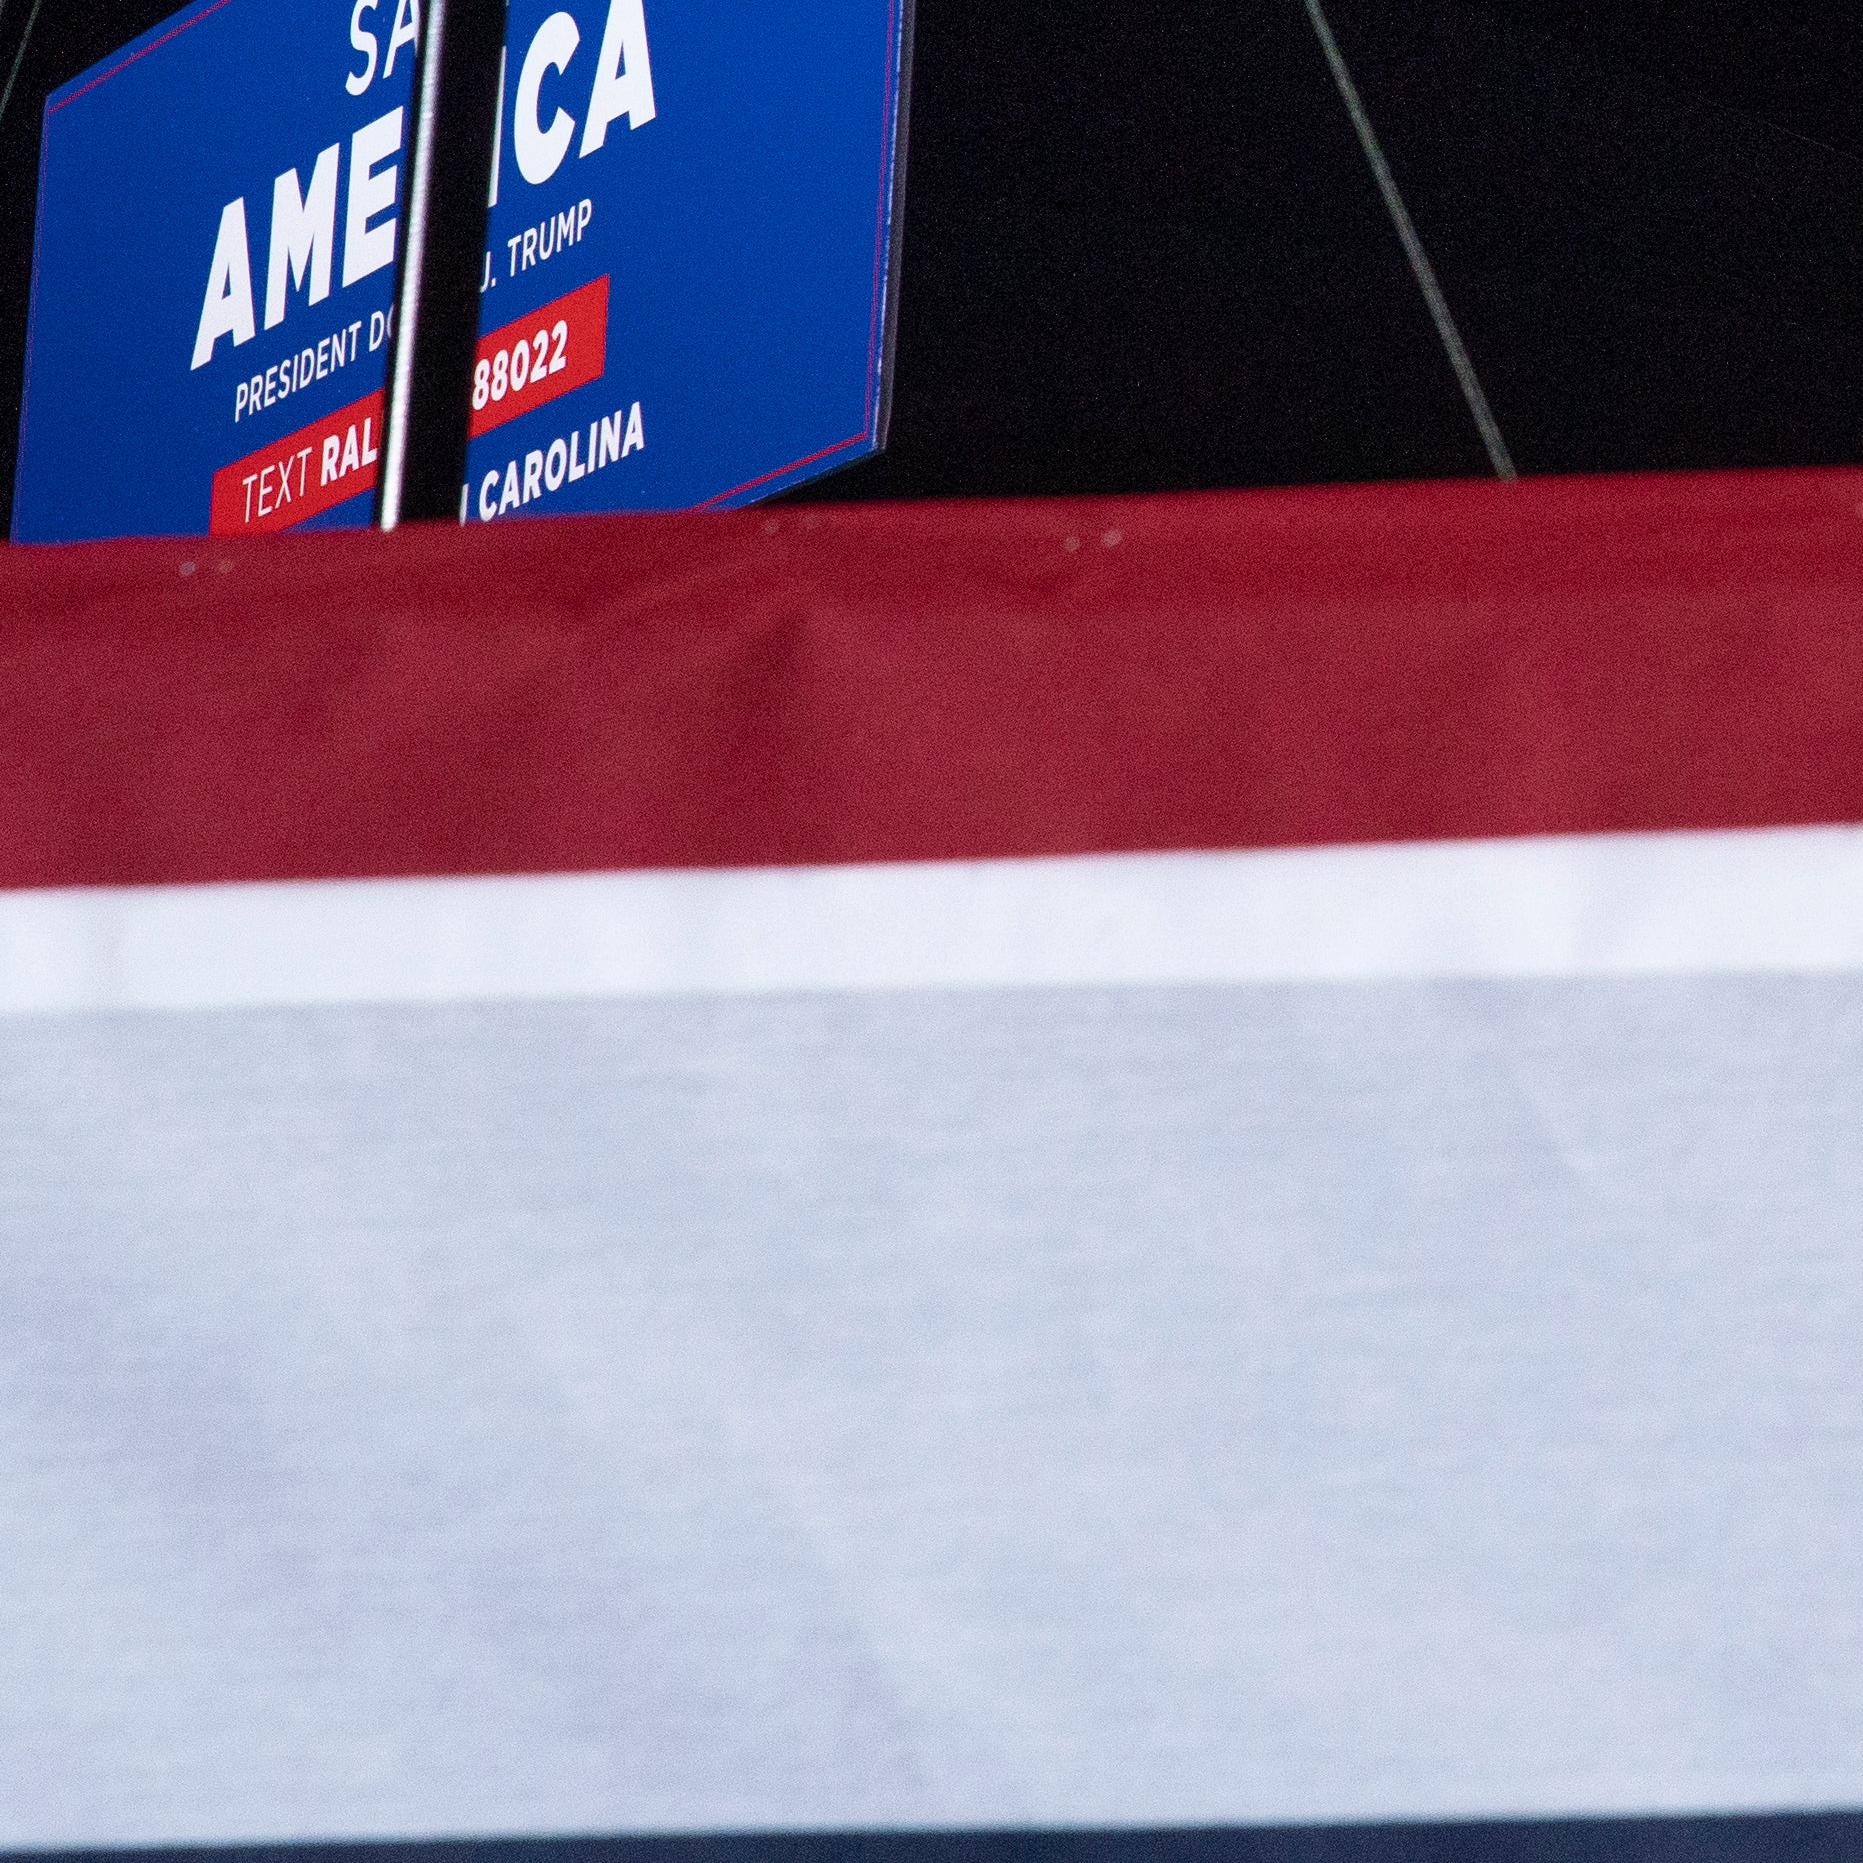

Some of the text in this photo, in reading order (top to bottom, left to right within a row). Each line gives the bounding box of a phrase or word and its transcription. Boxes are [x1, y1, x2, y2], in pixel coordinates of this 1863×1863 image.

[234, 320, 362, 423] PRESIDENT
[507, 198, 592, 277] TRUMP
[242, 446, 313, 523] TEXT
[320, 417, 378, 487] RAL
[472, 319, 568, 411] 88022
[478, 401, 645, 523] CAROLINA
